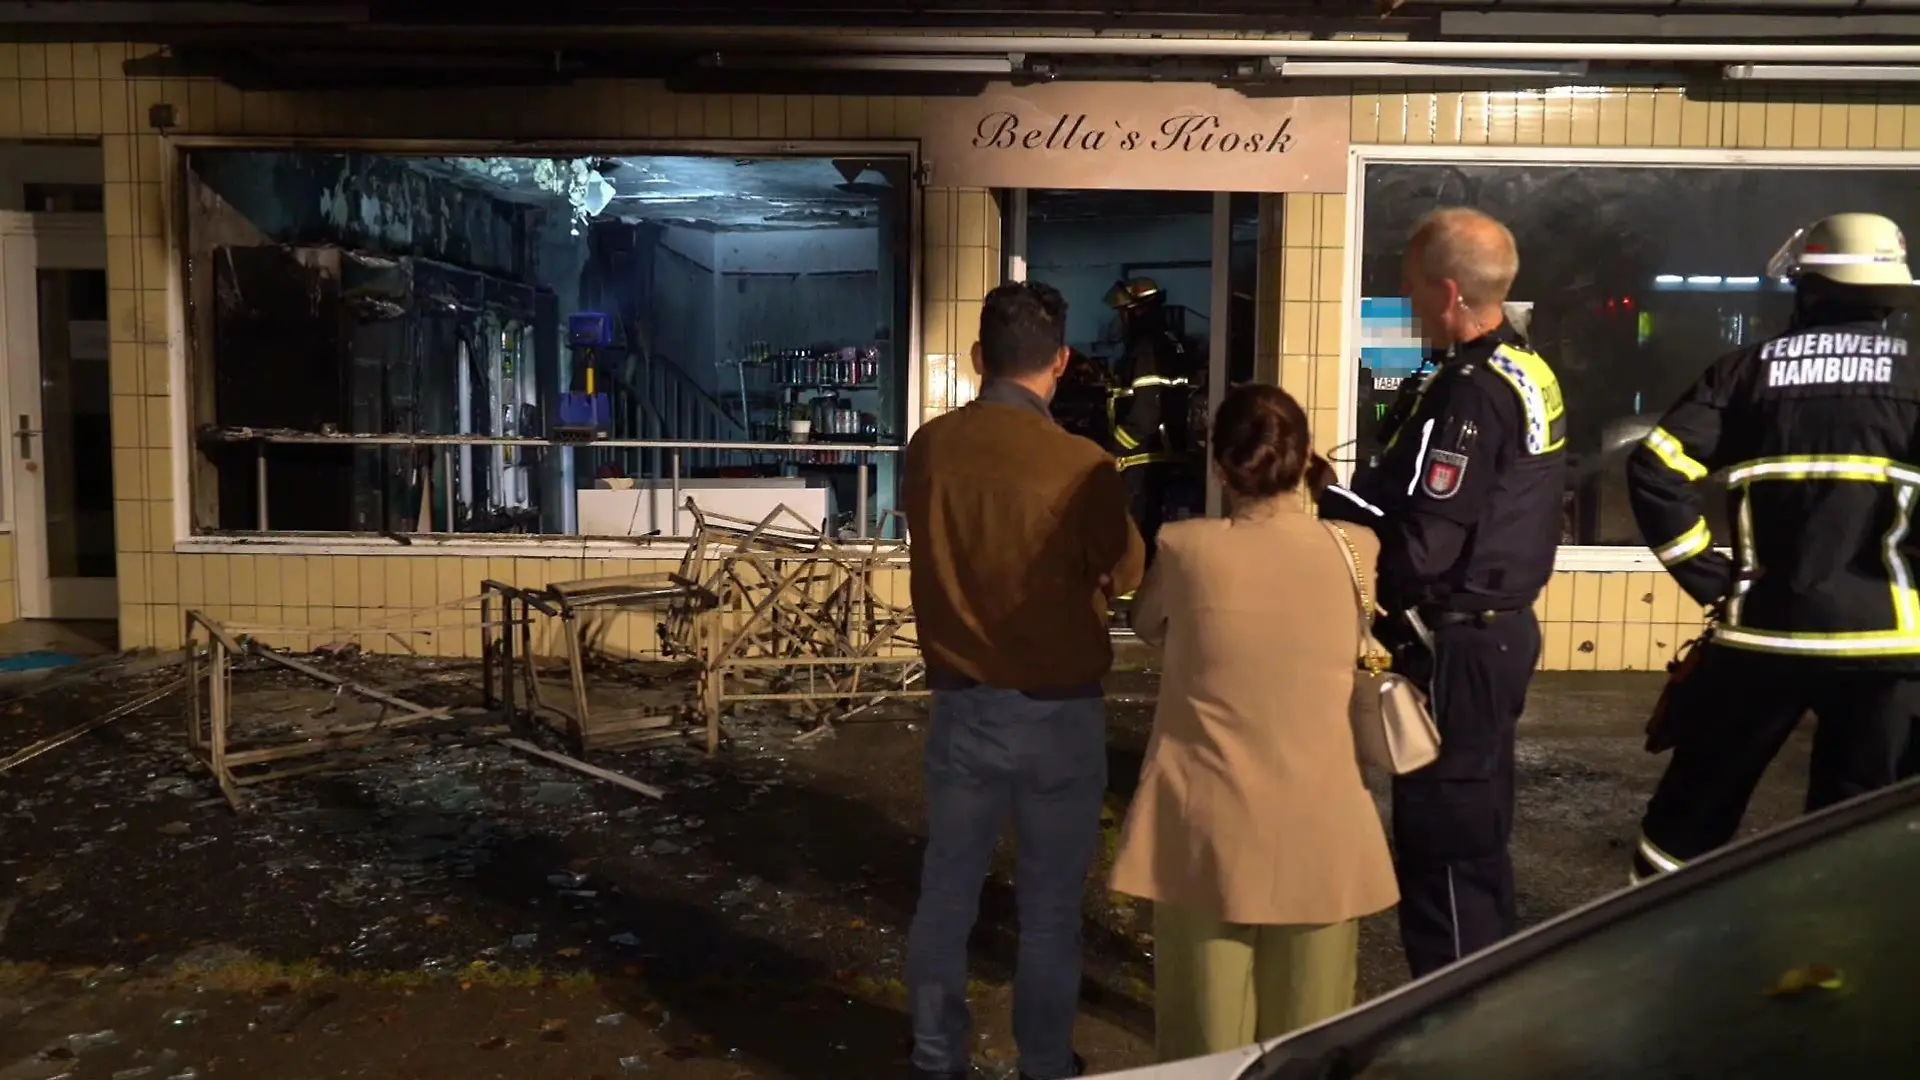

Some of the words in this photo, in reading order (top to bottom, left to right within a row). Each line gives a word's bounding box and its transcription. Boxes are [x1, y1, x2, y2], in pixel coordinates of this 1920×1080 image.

[1151, 114, 1295, 153] Kiosk
[1761, 333, 1908, 360] FEUERWEHR
[1374, 377, 1401, 390] TABA
[1769, 357, 1892, 387] HAMBURG
